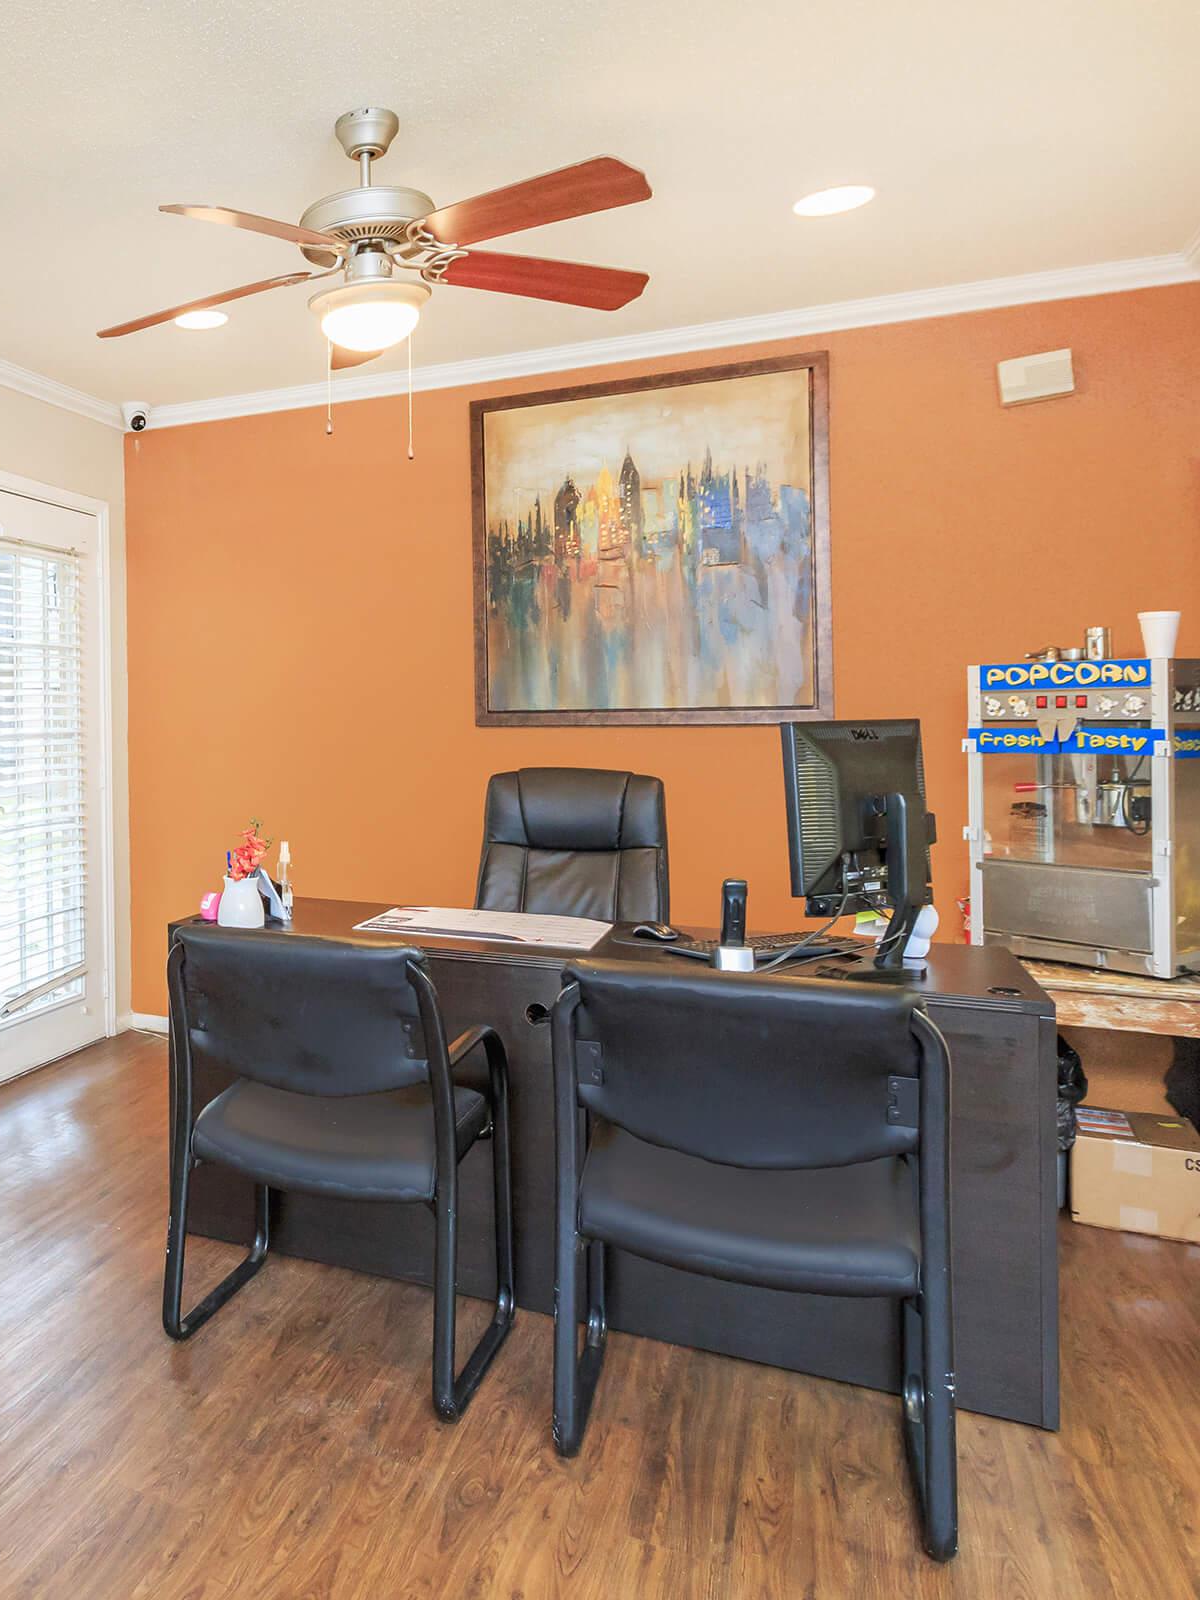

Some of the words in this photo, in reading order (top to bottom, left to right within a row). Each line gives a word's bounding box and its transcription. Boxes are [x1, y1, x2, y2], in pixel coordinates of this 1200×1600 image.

[986, 663, 1147, 686] POPCORN
[979, 732, 1046, 747] Fresh
[1076, 731, 1147, 751] Tasty
